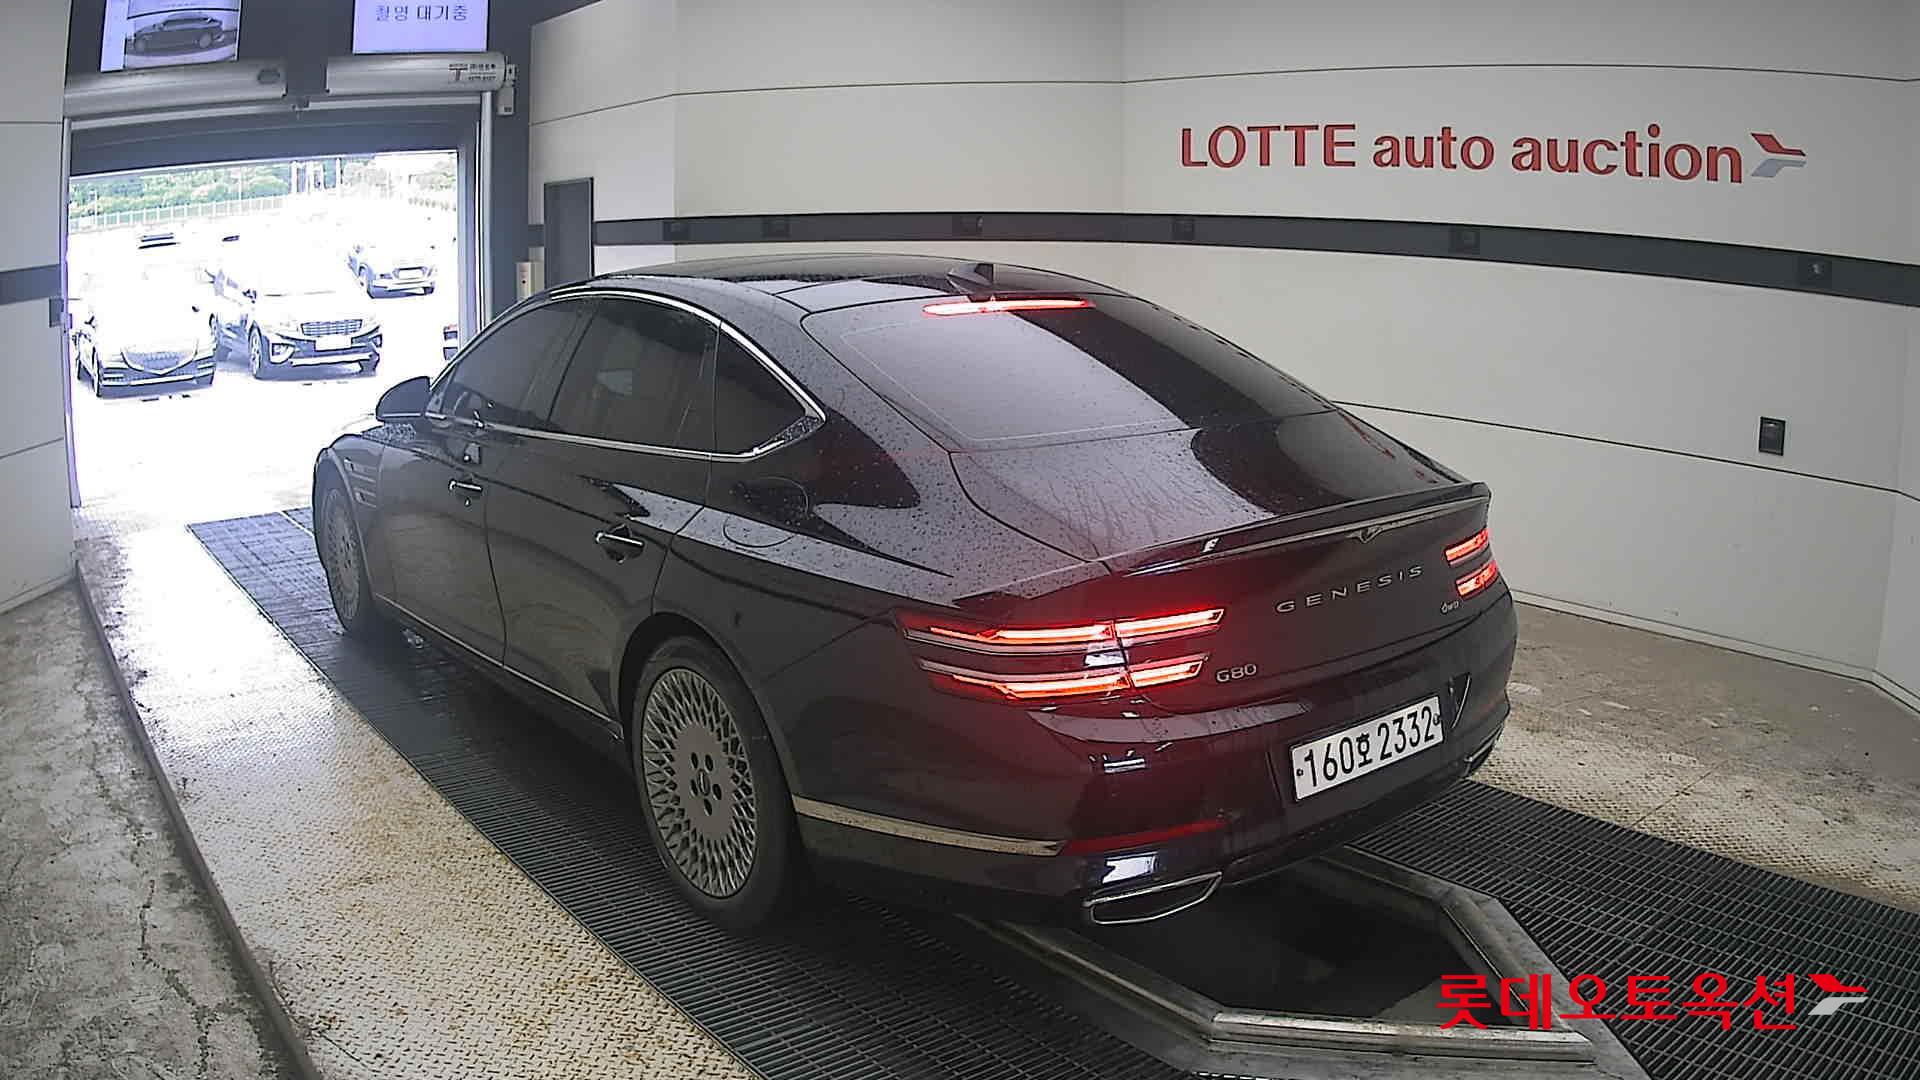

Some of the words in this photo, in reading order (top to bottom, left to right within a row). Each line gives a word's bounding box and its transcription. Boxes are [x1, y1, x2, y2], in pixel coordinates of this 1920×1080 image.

[417, 5, 467, 21] 대기중
[1181, 124, 1356, 168] LOTTE
[1373, 126, 1495, 170] auto
[1512, 123, 1743, 184] auction
[1275, 565, 1424, 613] GENESIS
[1216, 663, 1258, 683] G80
[1377, 706, 1434, 761] 2332
